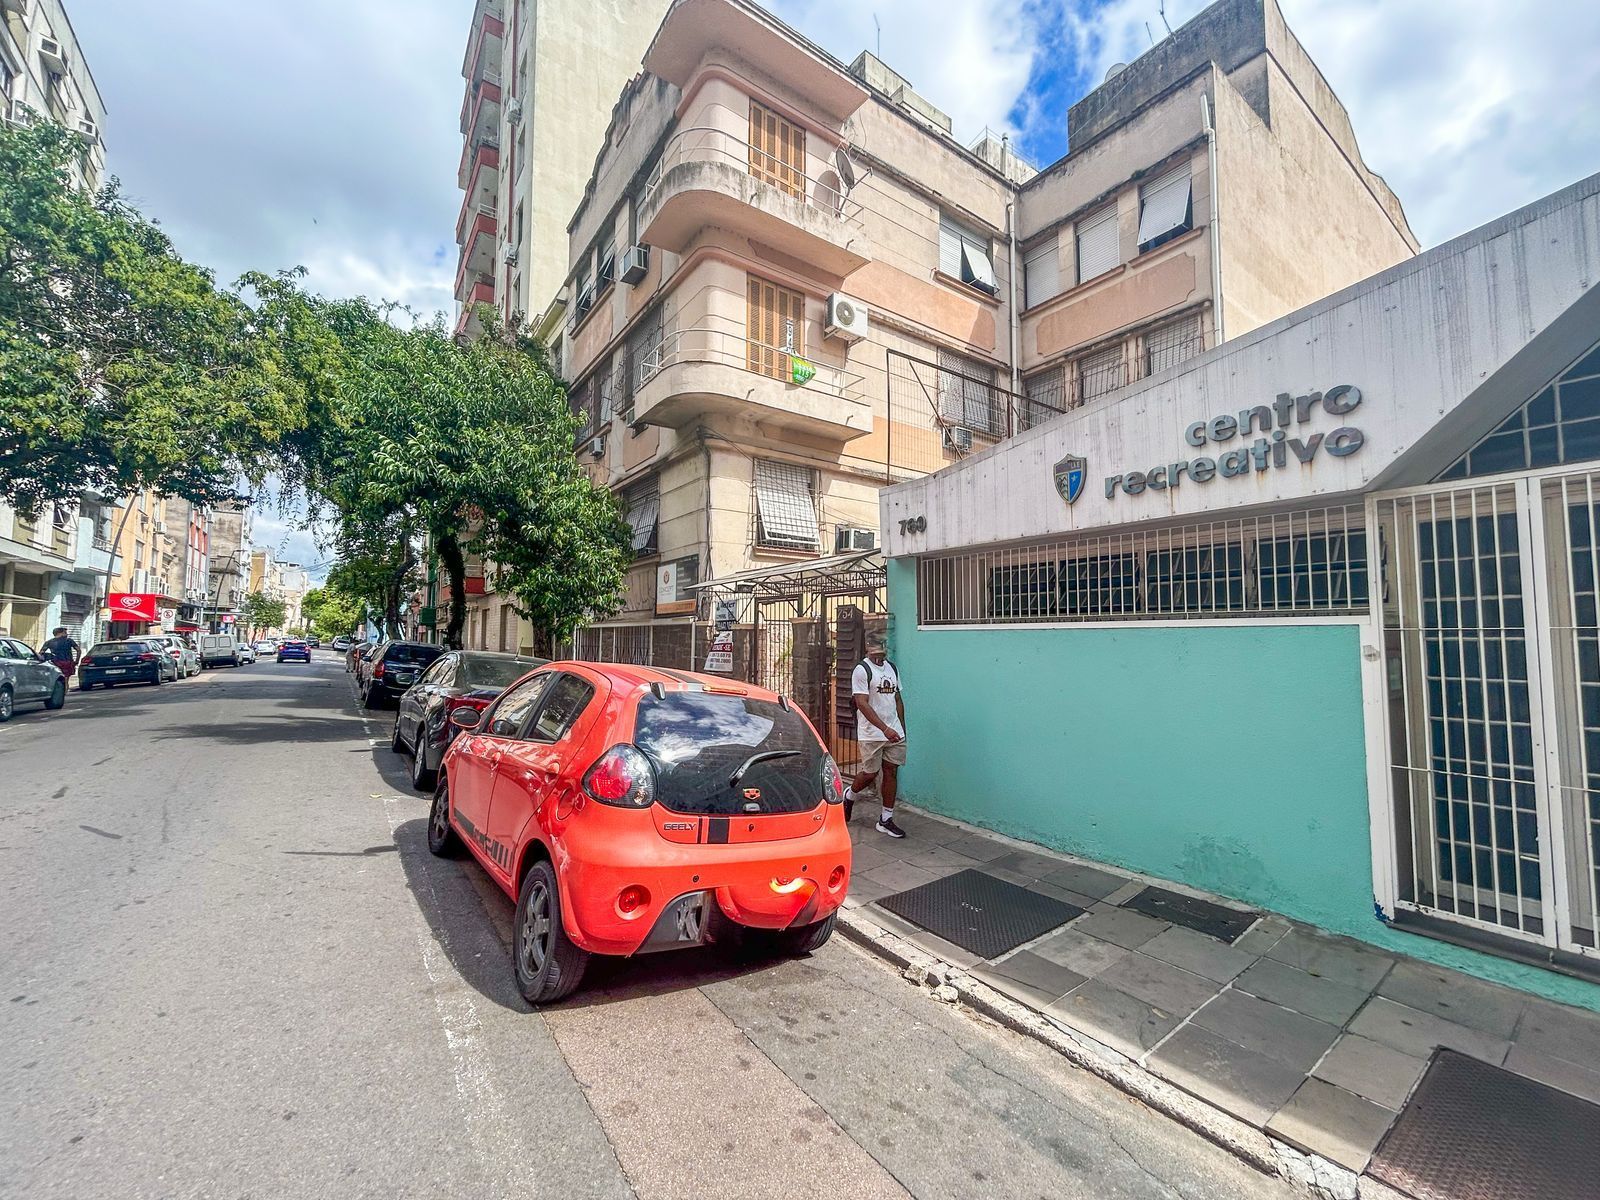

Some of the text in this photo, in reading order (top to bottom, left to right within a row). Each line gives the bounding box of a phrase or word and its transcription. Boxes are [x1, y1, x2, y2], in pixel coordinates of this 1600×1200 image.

[1185, 384, 1362, 447] centro
[1105, 426, 1365, 499] recreativo
[838, 608, 853, 620] 754
[663, 823, 696, 831] GEELY
